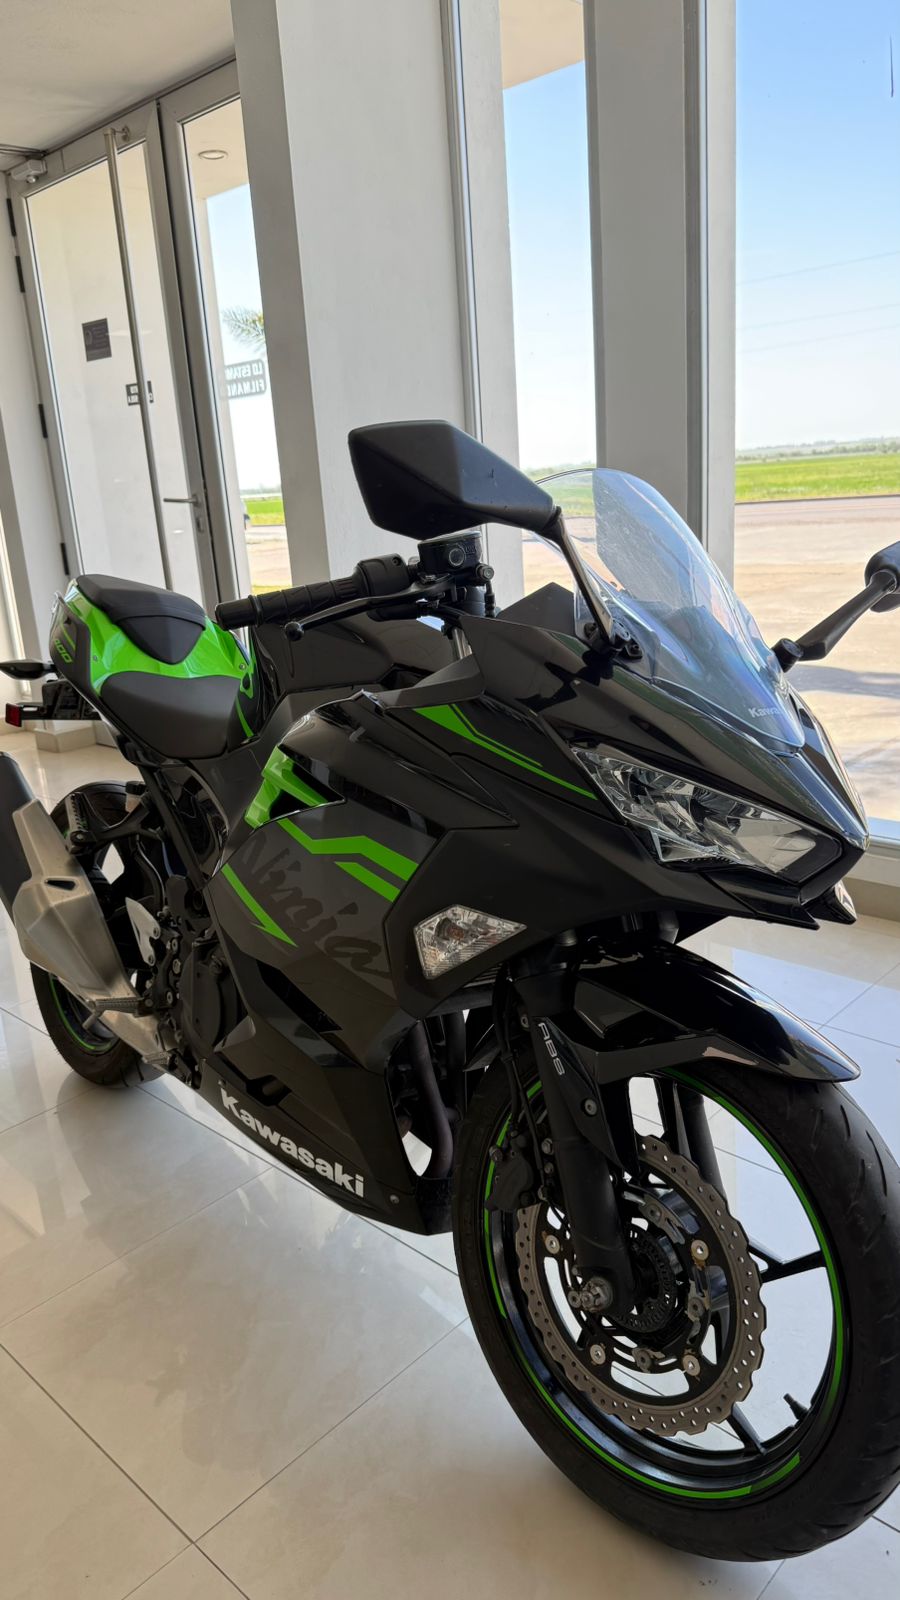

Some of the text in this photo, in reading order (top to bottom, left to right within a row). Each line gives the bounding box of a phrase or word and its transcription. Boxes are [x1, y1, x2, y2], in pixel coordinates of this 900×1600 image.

[239, 829, 393, 977] Ninja
[538, 1022, 565, 1076] ABS
[220, 1087, 364, 1198] Kawasaki
